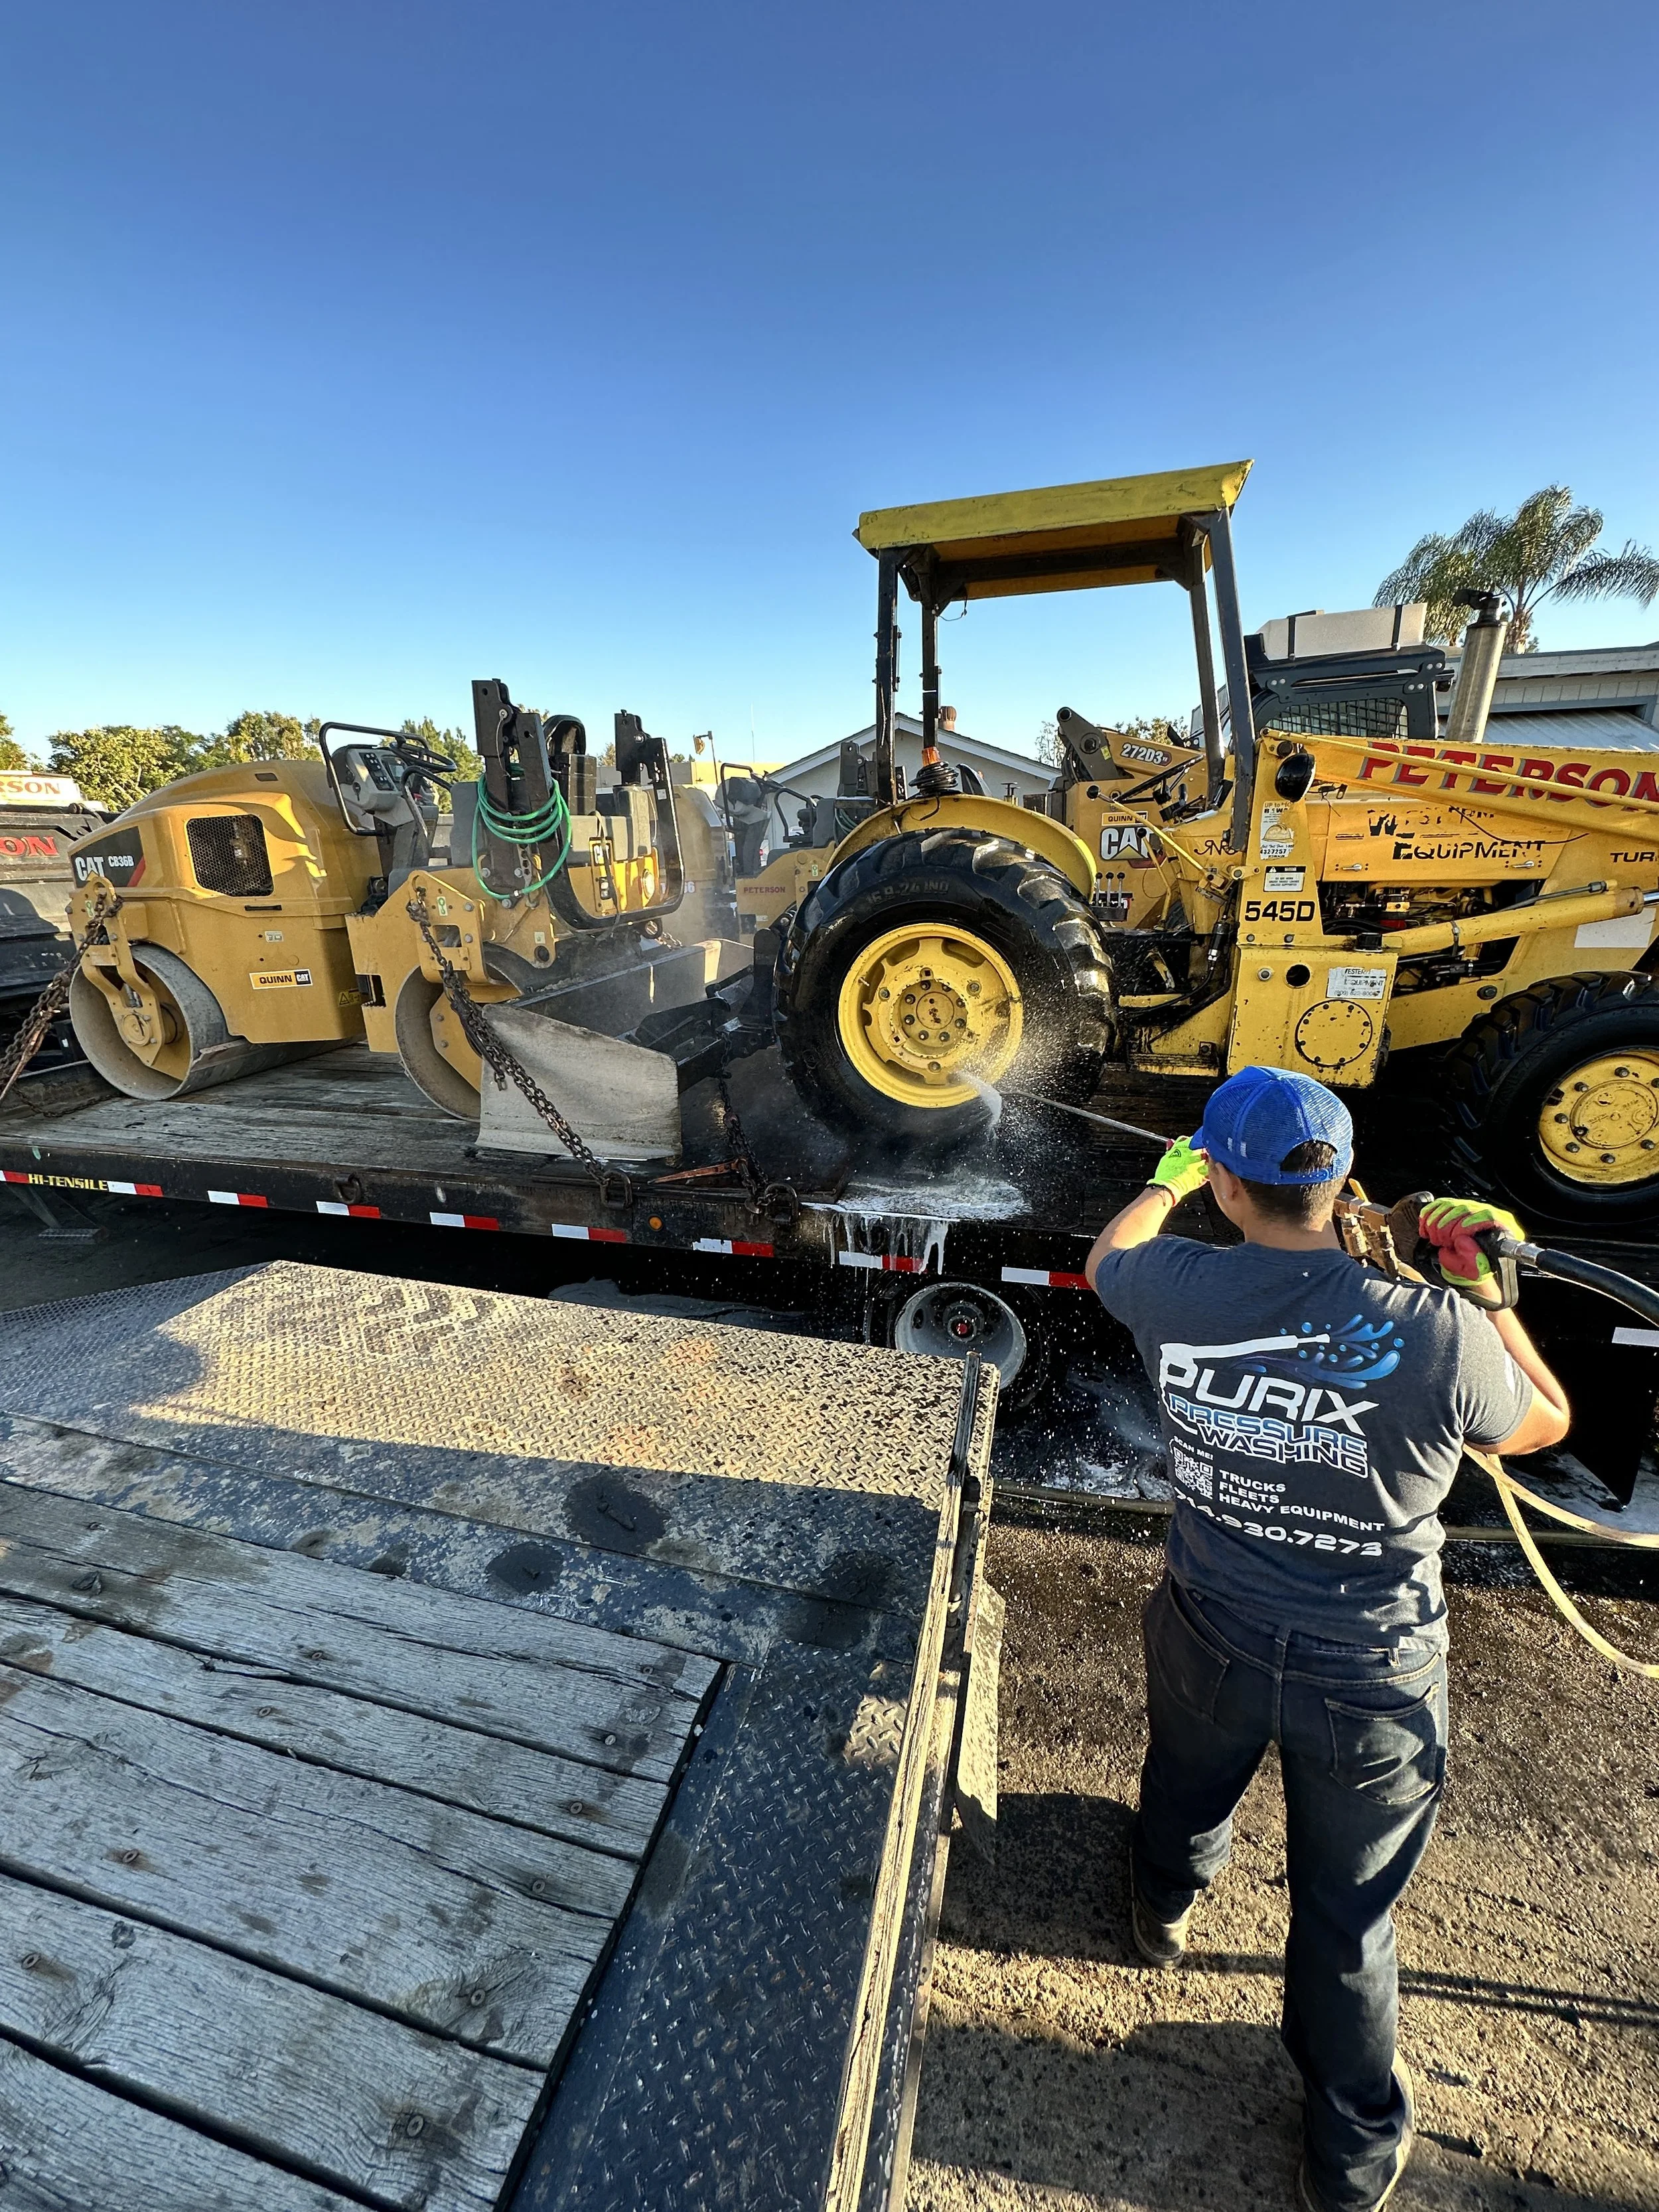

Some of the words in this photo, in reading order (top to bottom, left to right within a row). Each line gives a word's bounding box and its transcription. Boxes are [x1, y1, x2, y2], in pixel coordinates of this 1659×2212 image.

[1121, 744, 1163, 765] 272D3
[1356, 741, 1659, 814] PETERSON
[1101, 828, 1155, 860] CAT
[75, 857, 104, 881] CAT
[108, 855, 135, 867] CB36B
[1610, 851, 1657, 863] TUR
[1245, 901, 1315, 921] 545D
[259, 975, 293, 984] QUINN
[28, 1173, 108, 1191] HI-TENSILE
[1159, 1353, 1380, 1436] PURIX
[1169, 1392, 1368, 1455] PRESSURE
[1173, 1436, 1194, 1453] SCAN
[1196, 1449, 1214, 1460] ME!
[1196, 1422, 1368, 1479] WASHING
[1219, 1469, 1286, 1493] TRUCKS
[1219, 1481, 1279, 1504] FLEETS
[1219, 1493, 1275, 1514] HEAVY
[1280, 1505, 1385, 1532] EQUIPMENT
